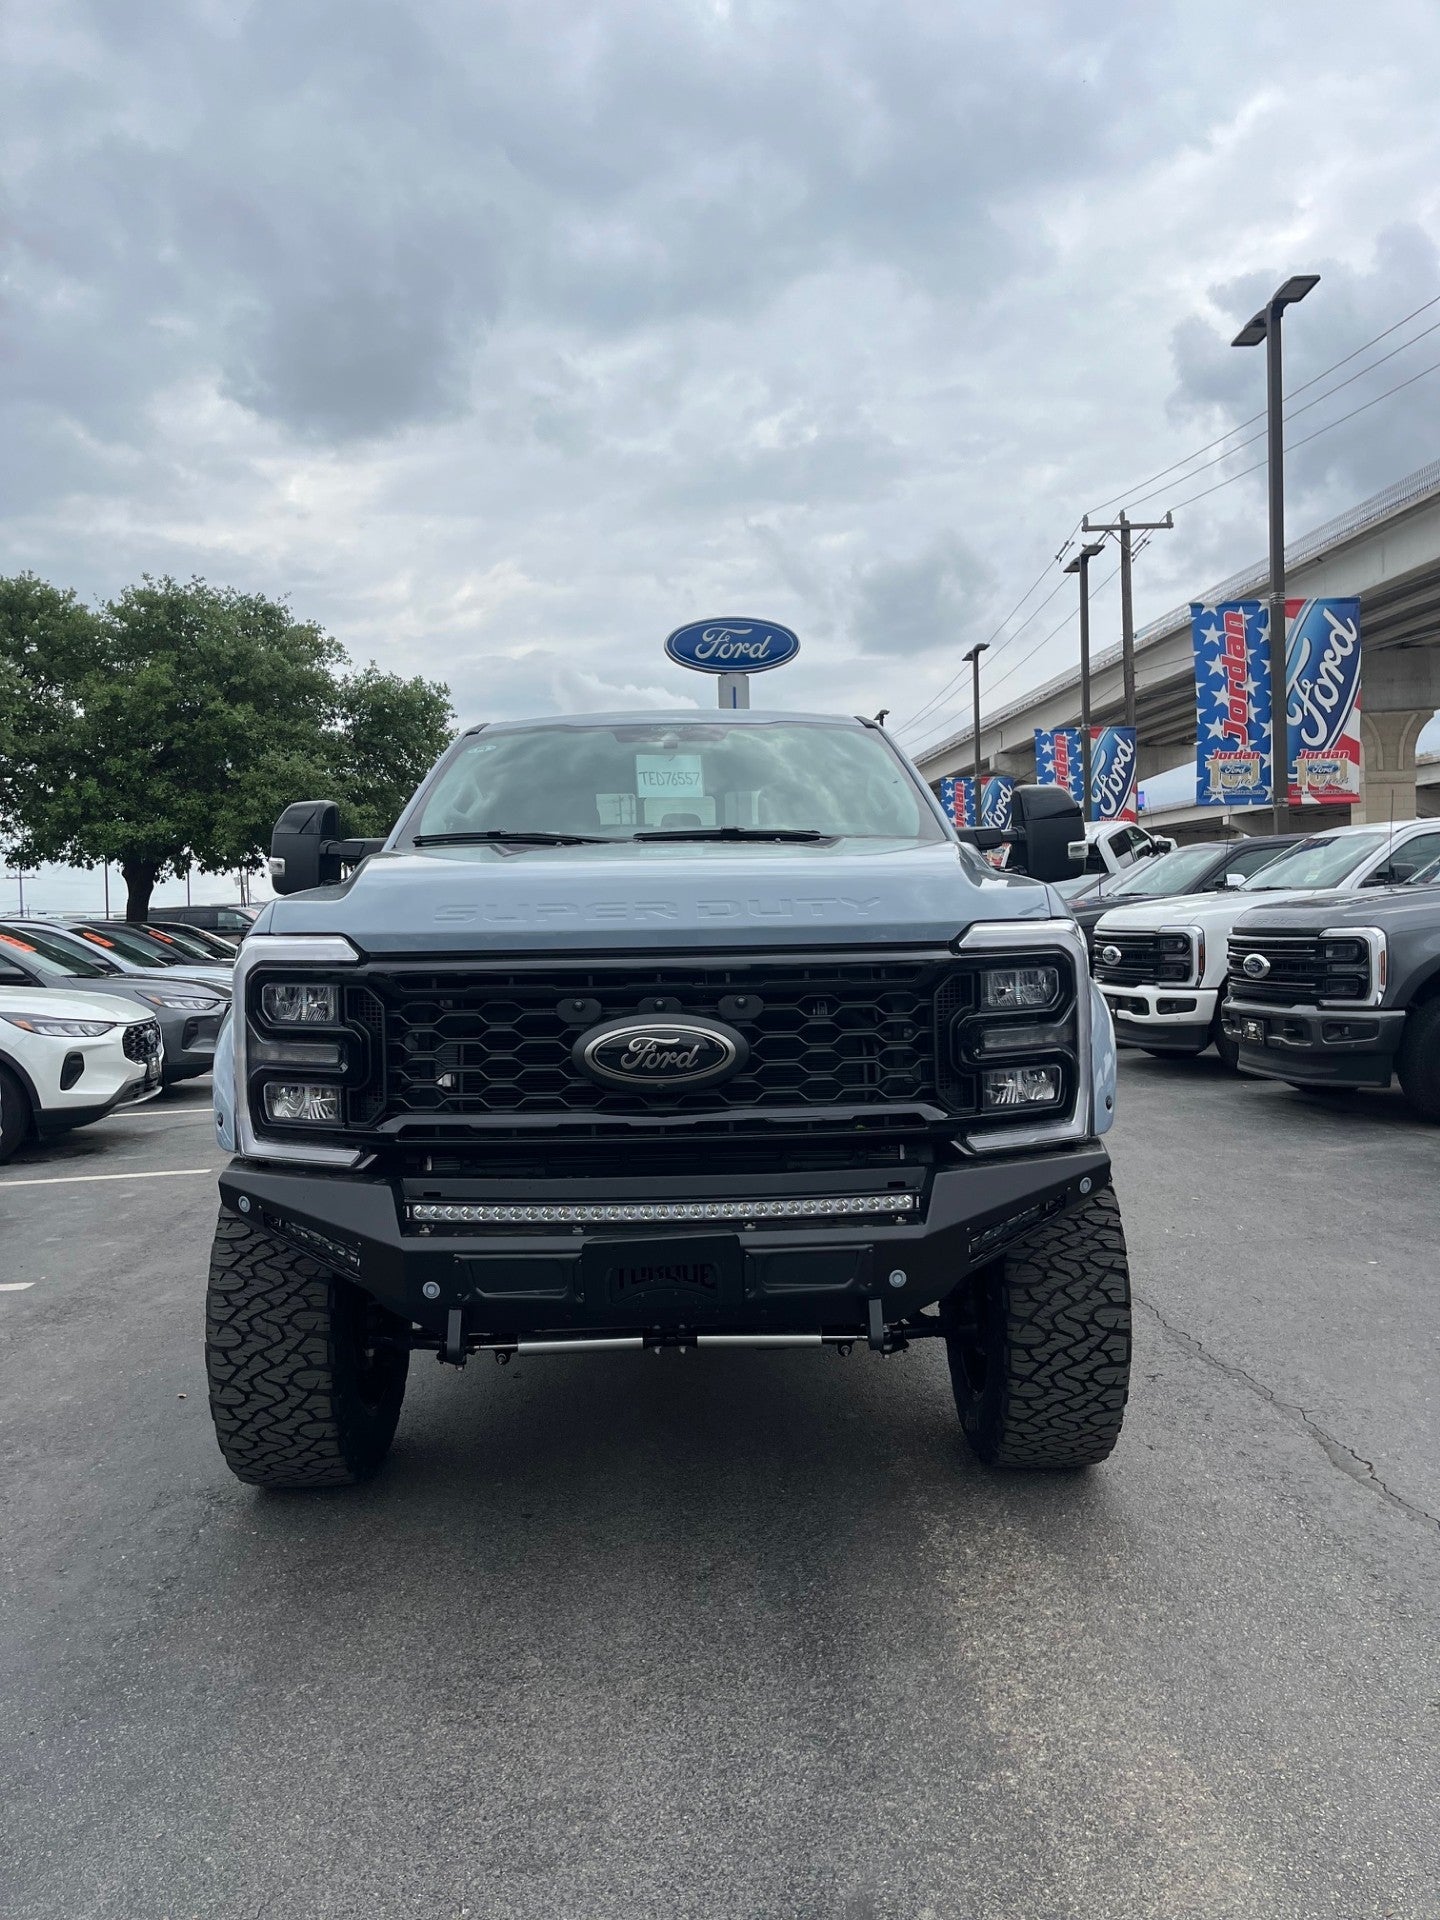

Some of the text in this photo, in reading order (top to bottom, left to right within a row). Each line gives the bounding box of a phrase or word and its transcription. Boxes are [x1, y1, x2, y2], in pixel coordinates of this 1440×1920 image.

[694, 627, 773, 659] Ford
[1220, 610, 1249, 747] Jordan
[1286, 607, 1358, 747] Ford
[1210, 749, 1261, 760] Jordan
[1296, 749, 1350, 760] Jordan
[1312, 763, 1335, 774] Ford
[638, 771, 700, 786] TED76557
[1091, 733, 1134, 815] Ford
[433, 896, 881, 925] SUPER DUTY
[620, 1037, 699, 1070] Ford
[616, 1262, 716, 1291] TORQUE
